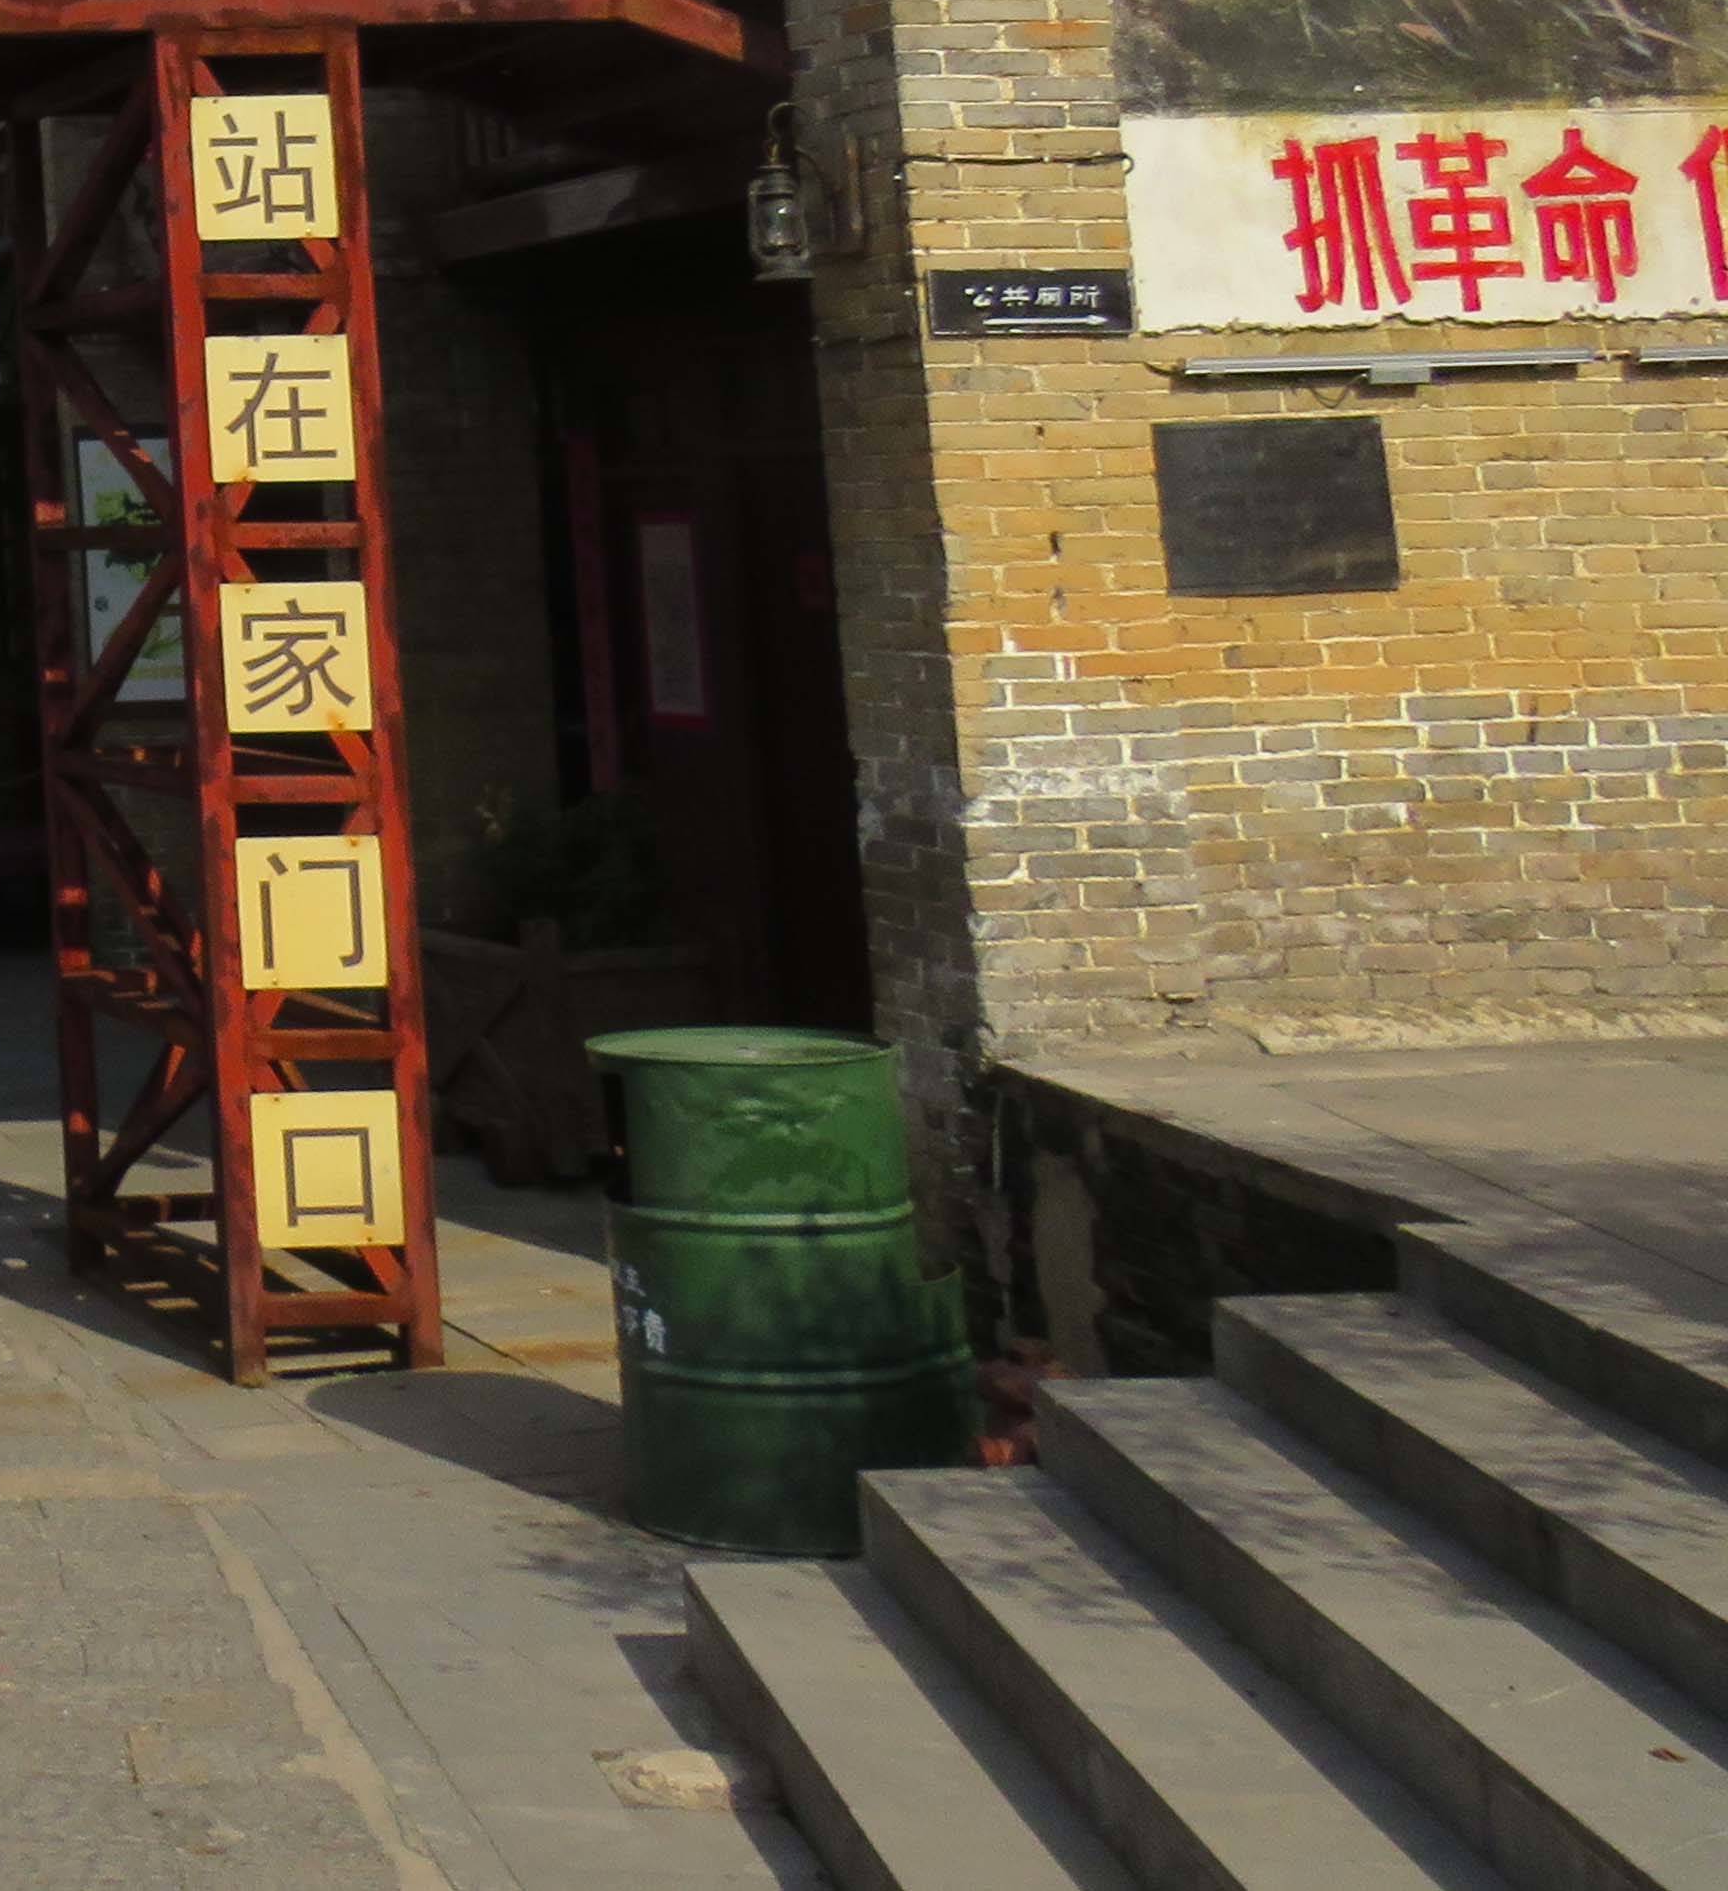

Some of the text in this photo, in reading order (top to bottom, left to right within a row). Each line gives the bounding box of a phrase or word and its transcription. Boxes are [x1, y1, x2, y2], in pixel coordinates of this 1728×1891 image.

[964, 284, 1102, 309] 公共厕所
[208, 111, 375, 1228] 站在家门口
